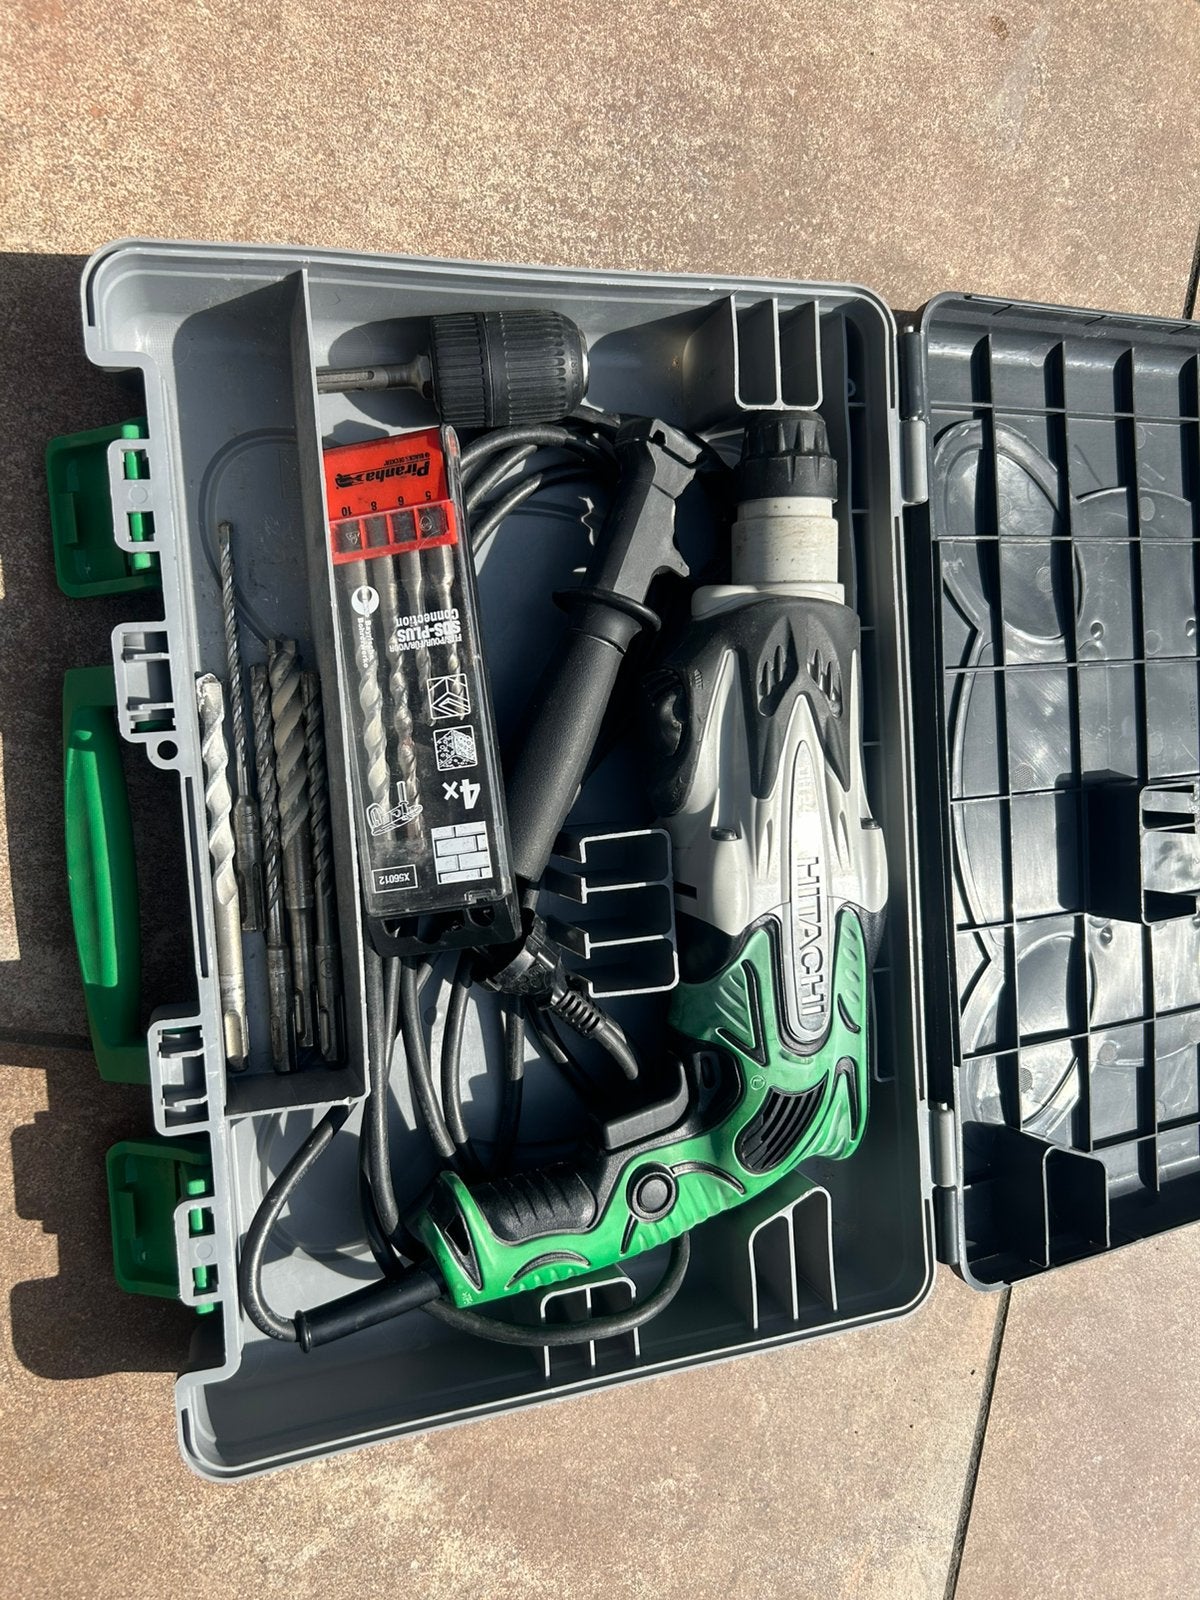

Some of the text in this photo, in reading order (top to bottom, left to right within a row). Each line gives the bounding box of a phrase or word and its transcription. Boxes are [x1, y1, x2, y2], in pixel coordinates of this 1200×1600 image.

[366, 461, 431, 482] Piranha
[341, 490, 432, 517] 5 6 8 10
[396, 608, 459, 627] Connection
[396, 620, 461, 642] SDS-PLUS
[379, 872, 410, 885] X56012
[797, 856, 825, 1017] HITACHI
